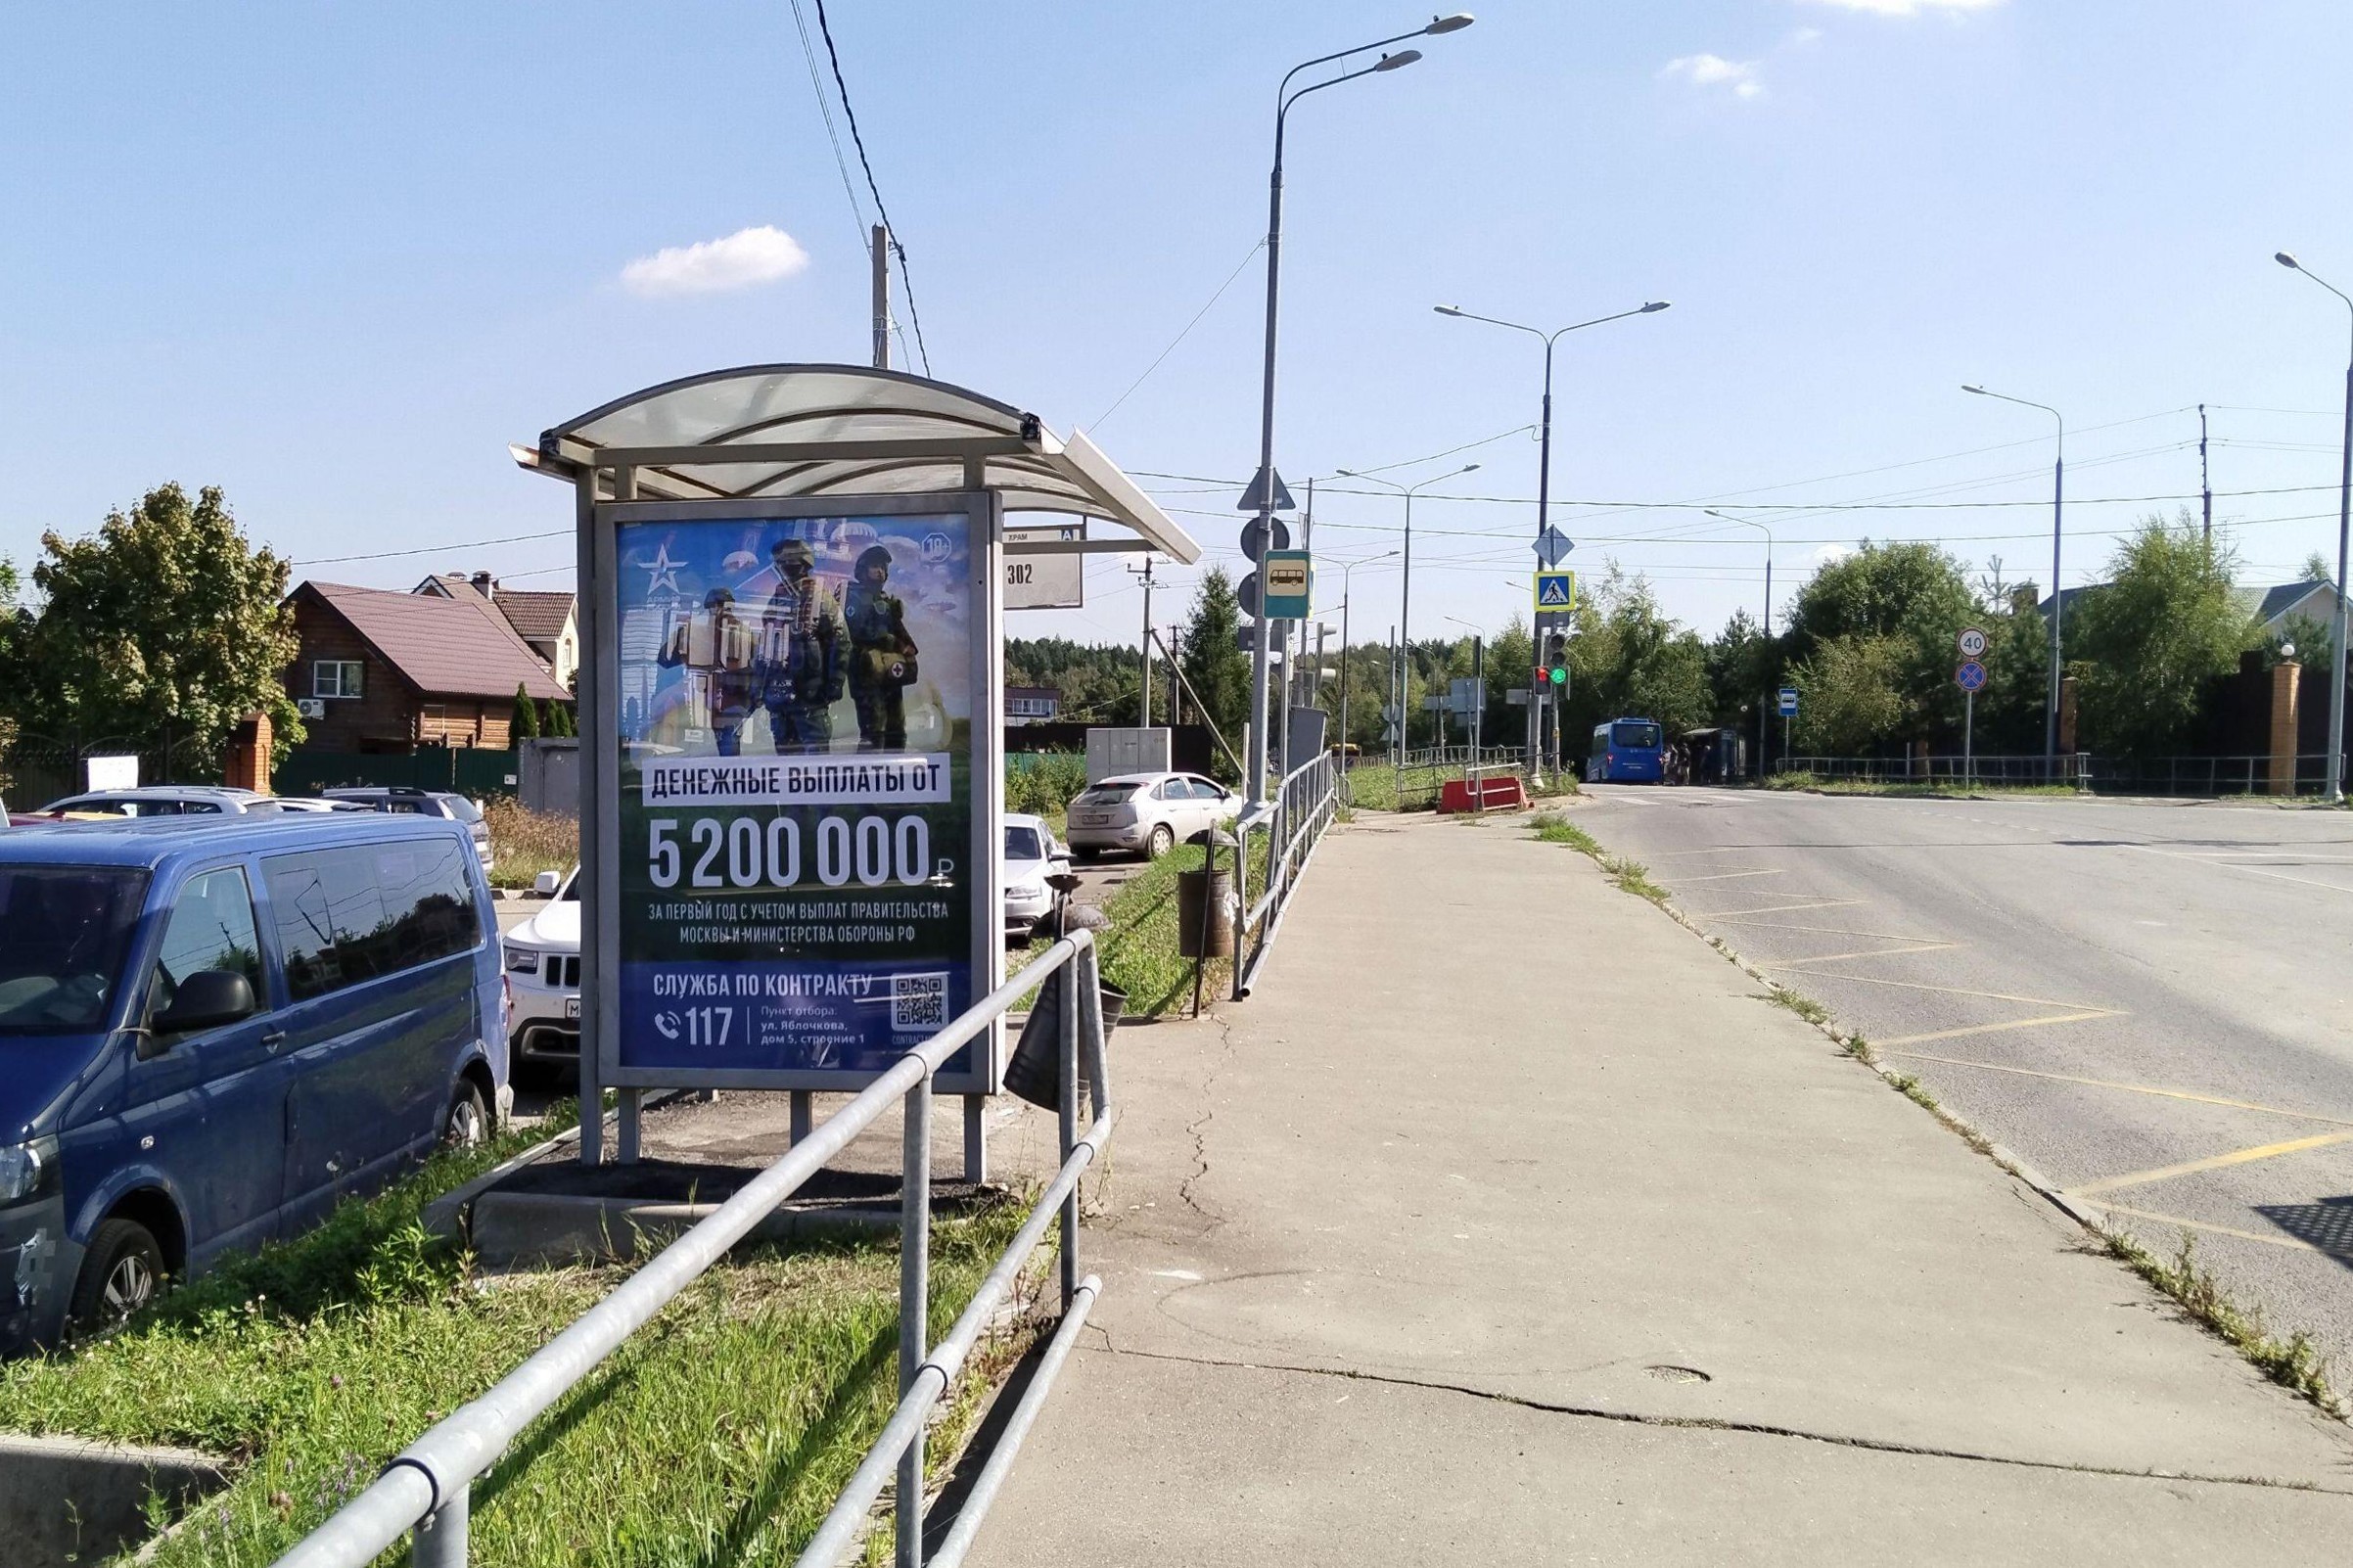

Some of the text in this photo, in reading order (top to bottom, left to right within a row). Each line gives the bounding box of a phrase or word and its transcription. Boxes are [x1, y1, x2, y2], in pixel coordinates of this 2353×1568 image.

[1007, 564, 1033, 584] 302
[1963, 637, 1982, 649] 40
[652, 764, 941, 799] ДЕНЕЖНЫЕ ВЫПЛАТЫ ОТ
[817, 815, 930, 887] 000
[648, 900, 948, 922] ЗА ПЕРВЫЙ ГОД С УЧЕТОМ ВЫПЛАТ ПРАВИТЕЛЬСТВА
[680, 925, 915, 944] МОСКВЫ И МИНИСТЕРСТВА ОБОРОНЫ РФ
[653, 973, 872, 999] СЛУЖБА ПО КОНТРАКТУ
[761, 1004, 838, 1019] Пункт отбора:
[685, 1006, 733, 1045] 117
[761, 1021, 848, 1033] ул. Яблочкова,
[761, 1035, 865, 1046] дом 5, строение 1
